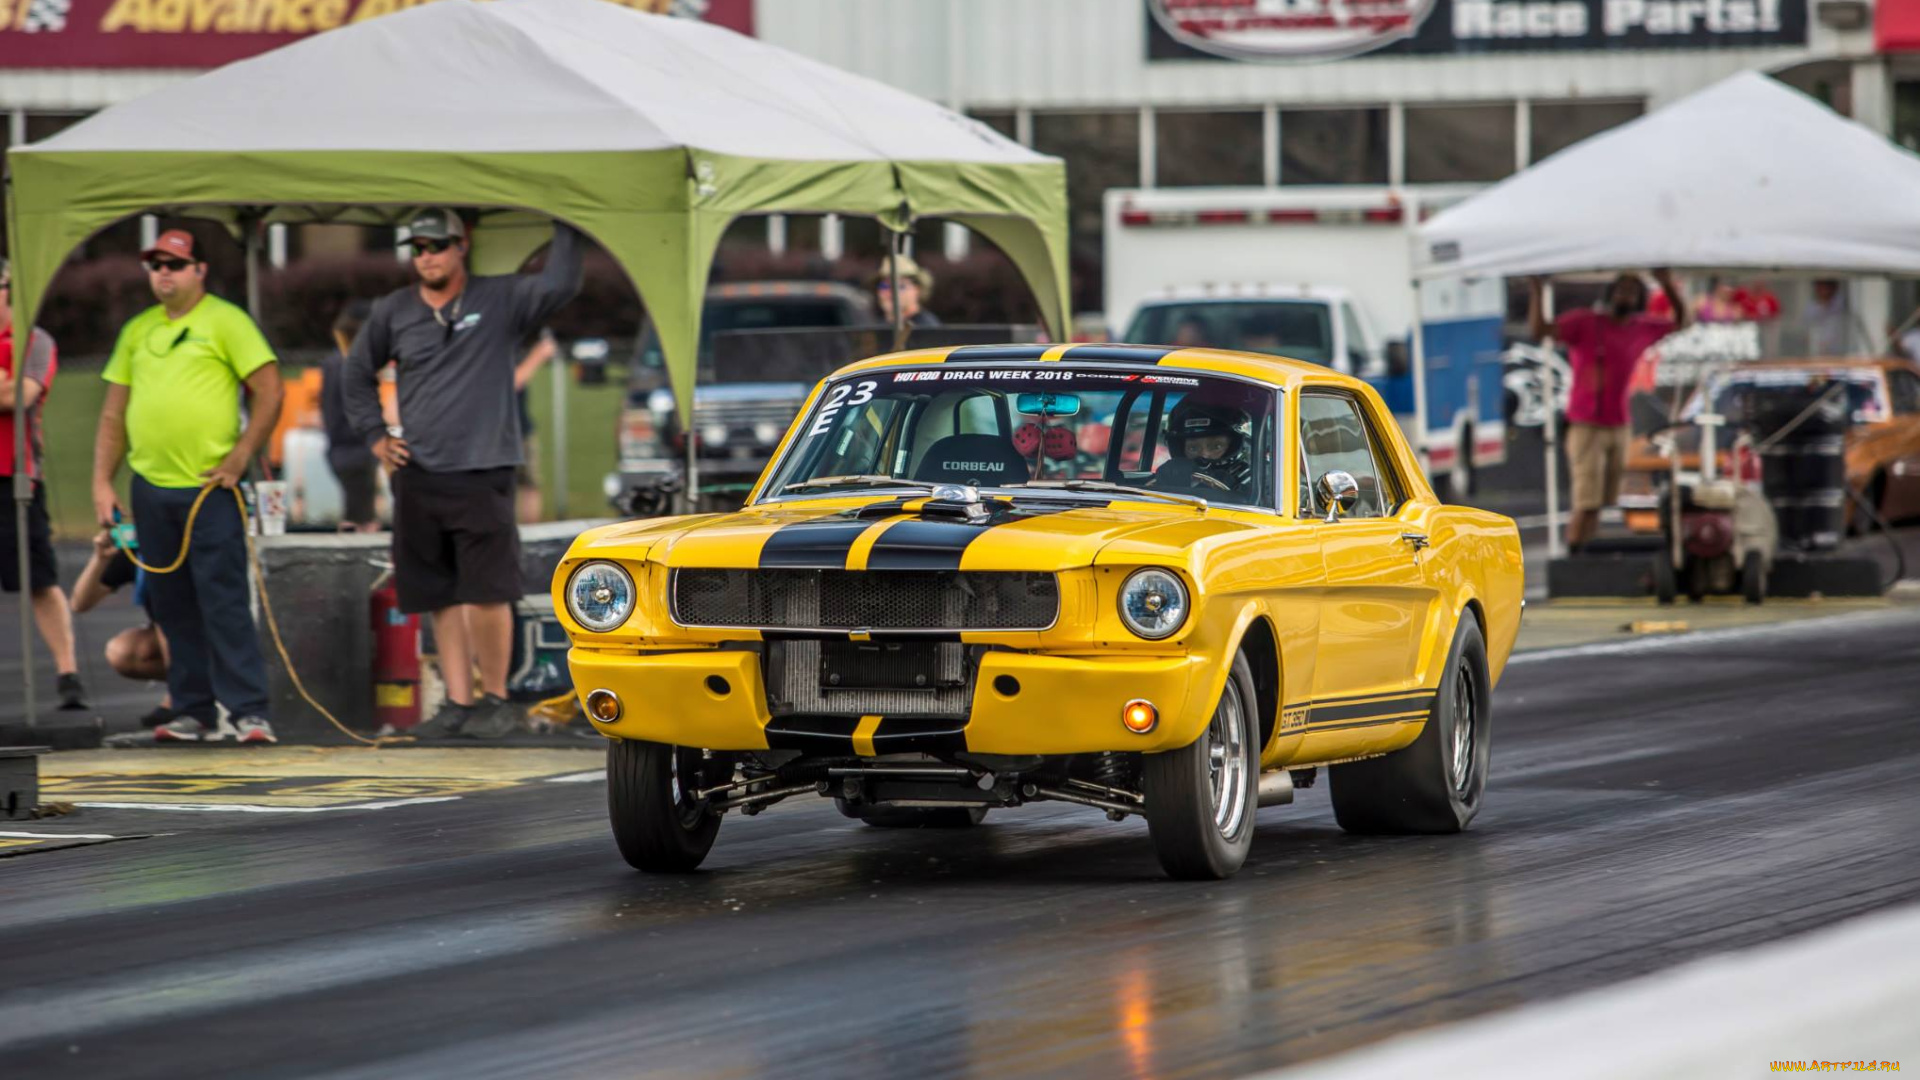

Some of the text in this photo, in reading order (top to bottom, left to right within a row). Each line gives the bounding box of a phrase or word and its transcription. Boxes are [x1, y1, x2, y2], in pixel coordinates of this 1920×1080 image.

[101, 0, 347, 33] Advance
[1453, 0, 1589, 39] Race
[1602, 0, 1780, 36] Parts!
[943, 371, 985, 380] DRAG
[988, 370, 1032, 380] WEEK
[1034, 371, 1073, 381] 2018
[821, 380, 878, 412] 23
[808, 408, 840, 438] E
[942, 461, 1005, 472] CORBEAU
